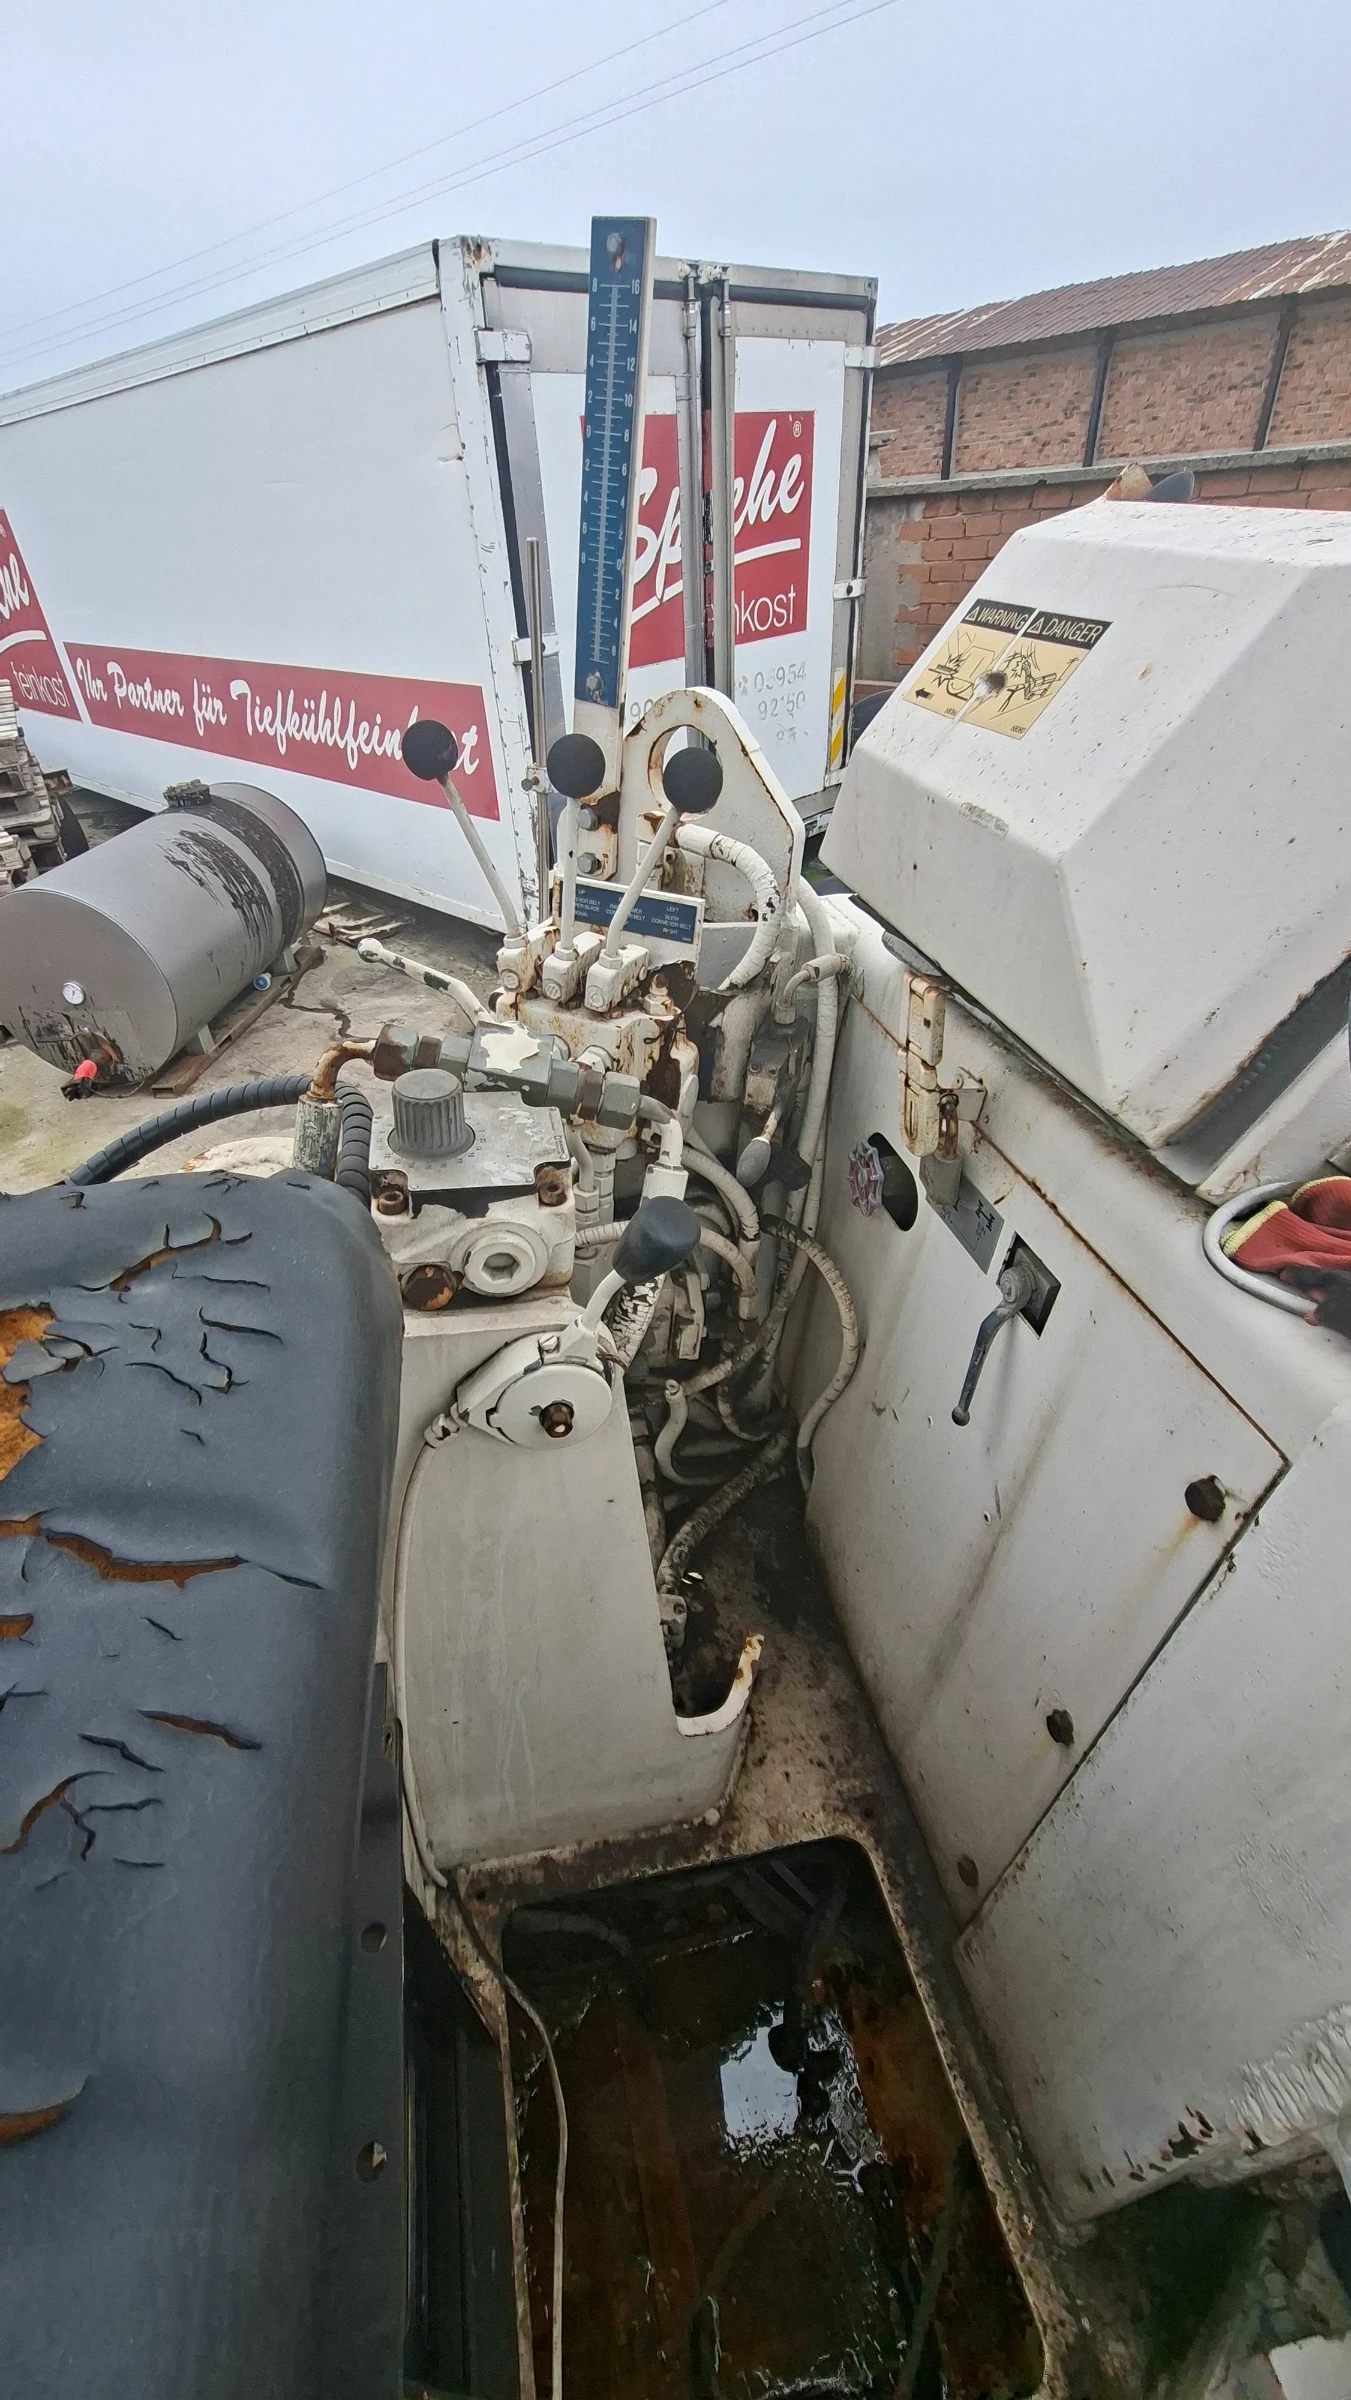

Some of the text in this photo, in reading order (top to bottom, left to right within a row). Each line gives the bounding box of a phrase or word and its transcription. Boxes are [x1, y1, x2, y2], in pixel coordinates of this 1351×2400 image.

[592, 280, 598, 293] 8
[632, 279, 640, 295] 16
[590, 317, 596, 331] 6
[629, 319, 637, 335] 14
[589, 355, 594, 368] 4
[627, 357, 635, 372] 12
[587, 391, 593, 404] 2
[624, 393, 633, 408] 10
[586, 425, 591, 438] 0
[623, 428, 630, 442] 8
[585, 458, 590, 471] 2
[621, 463, 627, 477] 6
[583, 490, 588, 504] 4
[620, 496, 625, 509] 4
[582, 521, 588, 534] 6
[618, 526, 624, 540] 2
[616, 558, 622, 571] 0
[615, 588, 620, 600] 2
[613, 617, 618, 629] 4
[978, 606, 1029, 632] WARNING
[1042, 618, 1104, 645] DANGER
[611, 645, 617, 657] 6
[77, 657, 108, 702] Ihr
[107, 661, 185, 717] Partner
[192, 678, 227, 737] für
[666, 906, 679, 914] LEFT
[664, 914, 680, 922] SLEW
[679, 923, 692, 931] BELT
